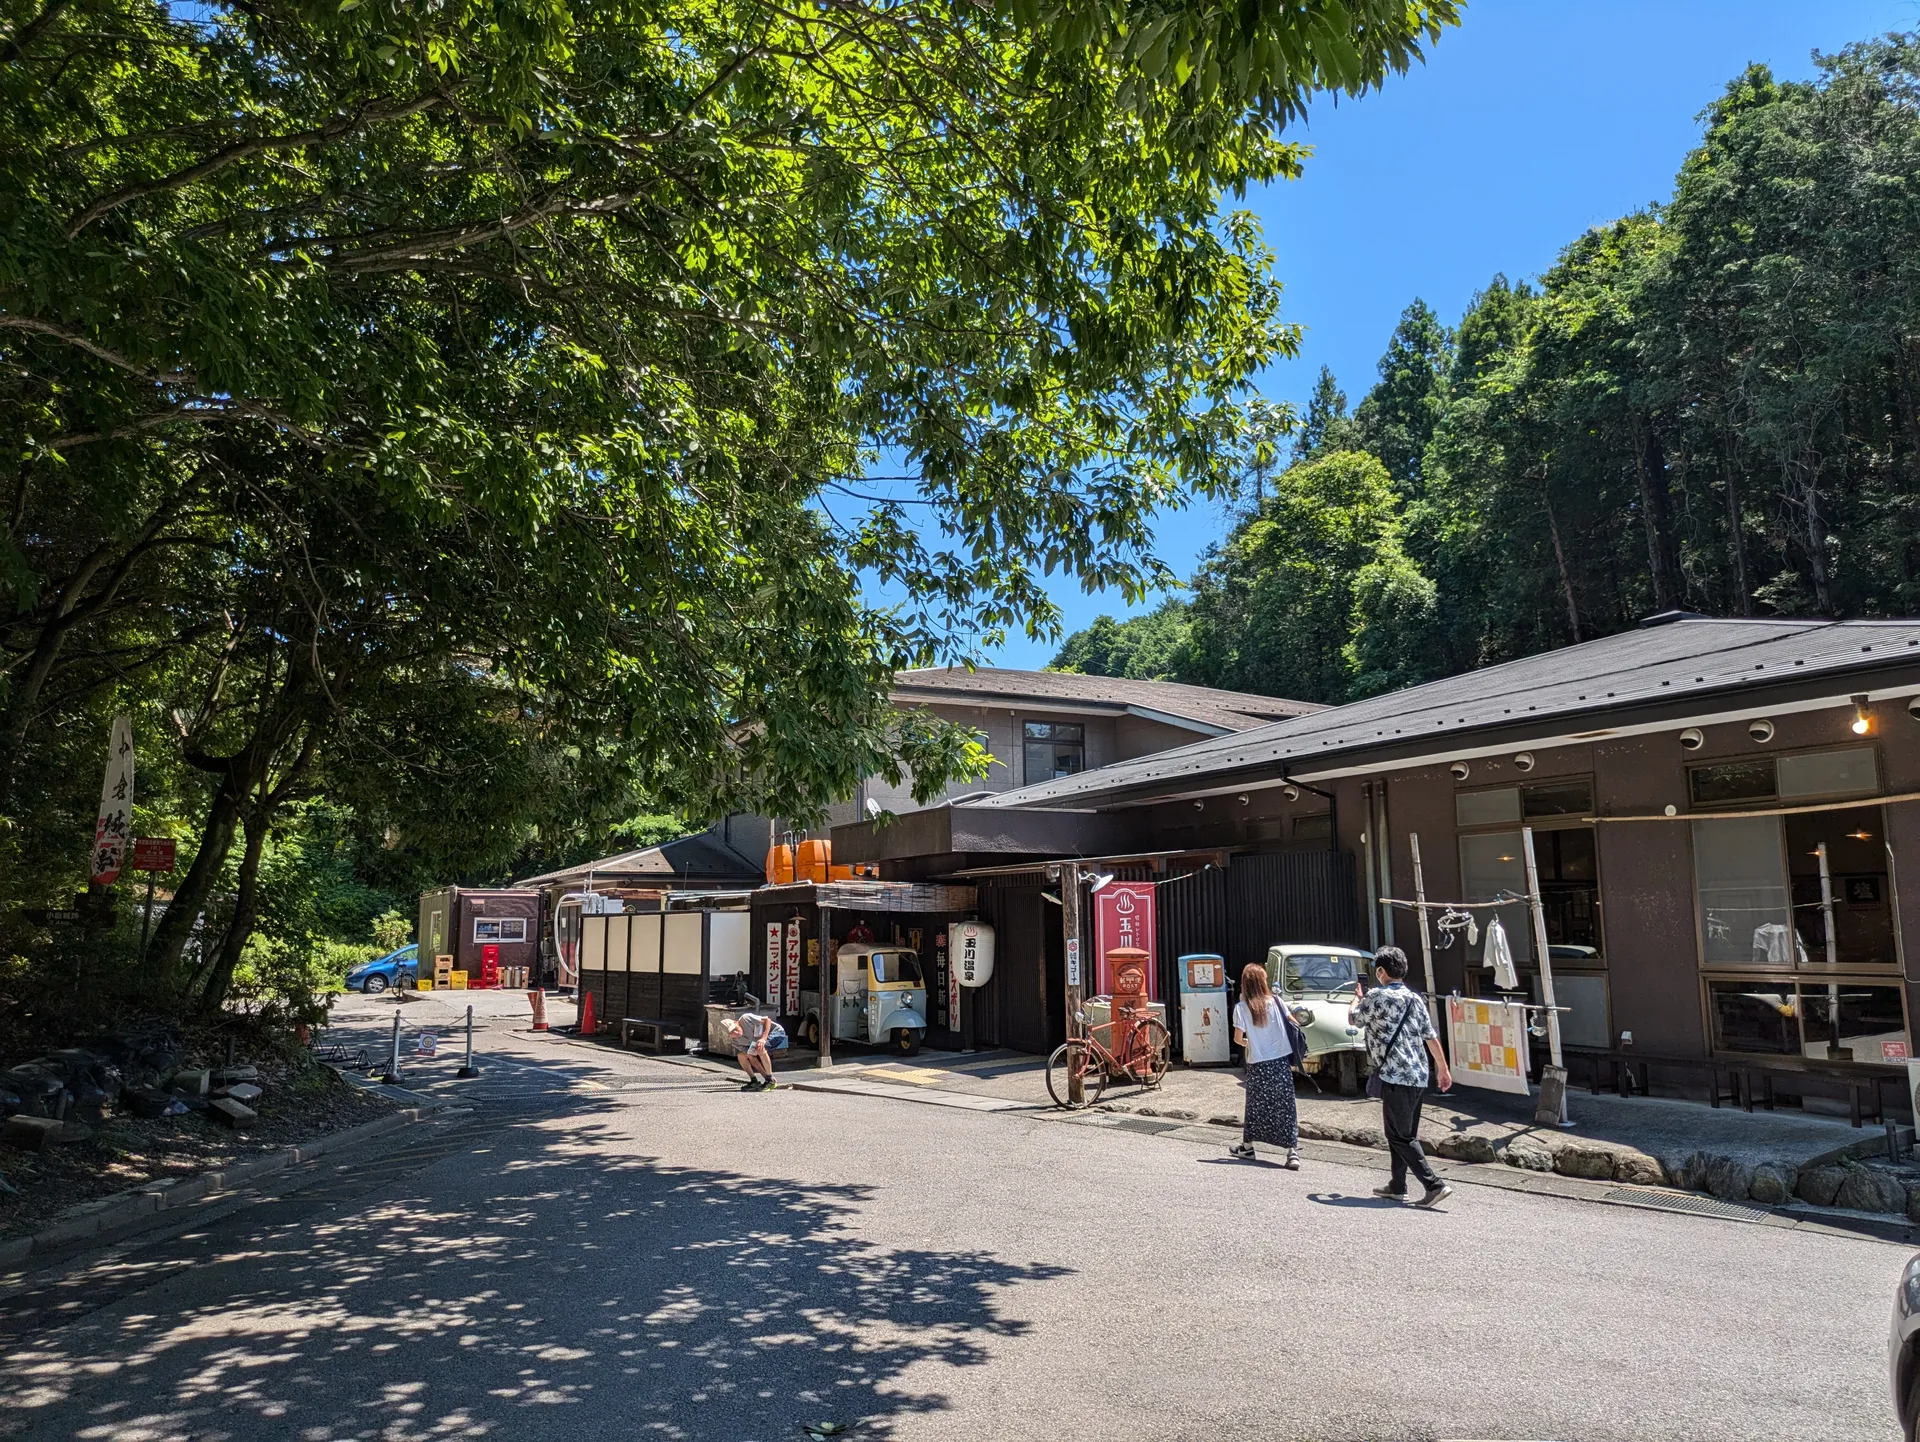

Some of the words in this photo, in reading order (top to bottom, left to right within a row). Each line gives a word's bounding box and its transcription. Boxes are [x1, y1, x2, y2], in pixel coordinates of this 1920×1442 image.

[788, 939, 799, 1012] アサヒビール
[936, 951, 946, 1026] 毎日新聞
[963, 938, 977, 980] 玉川温泉
